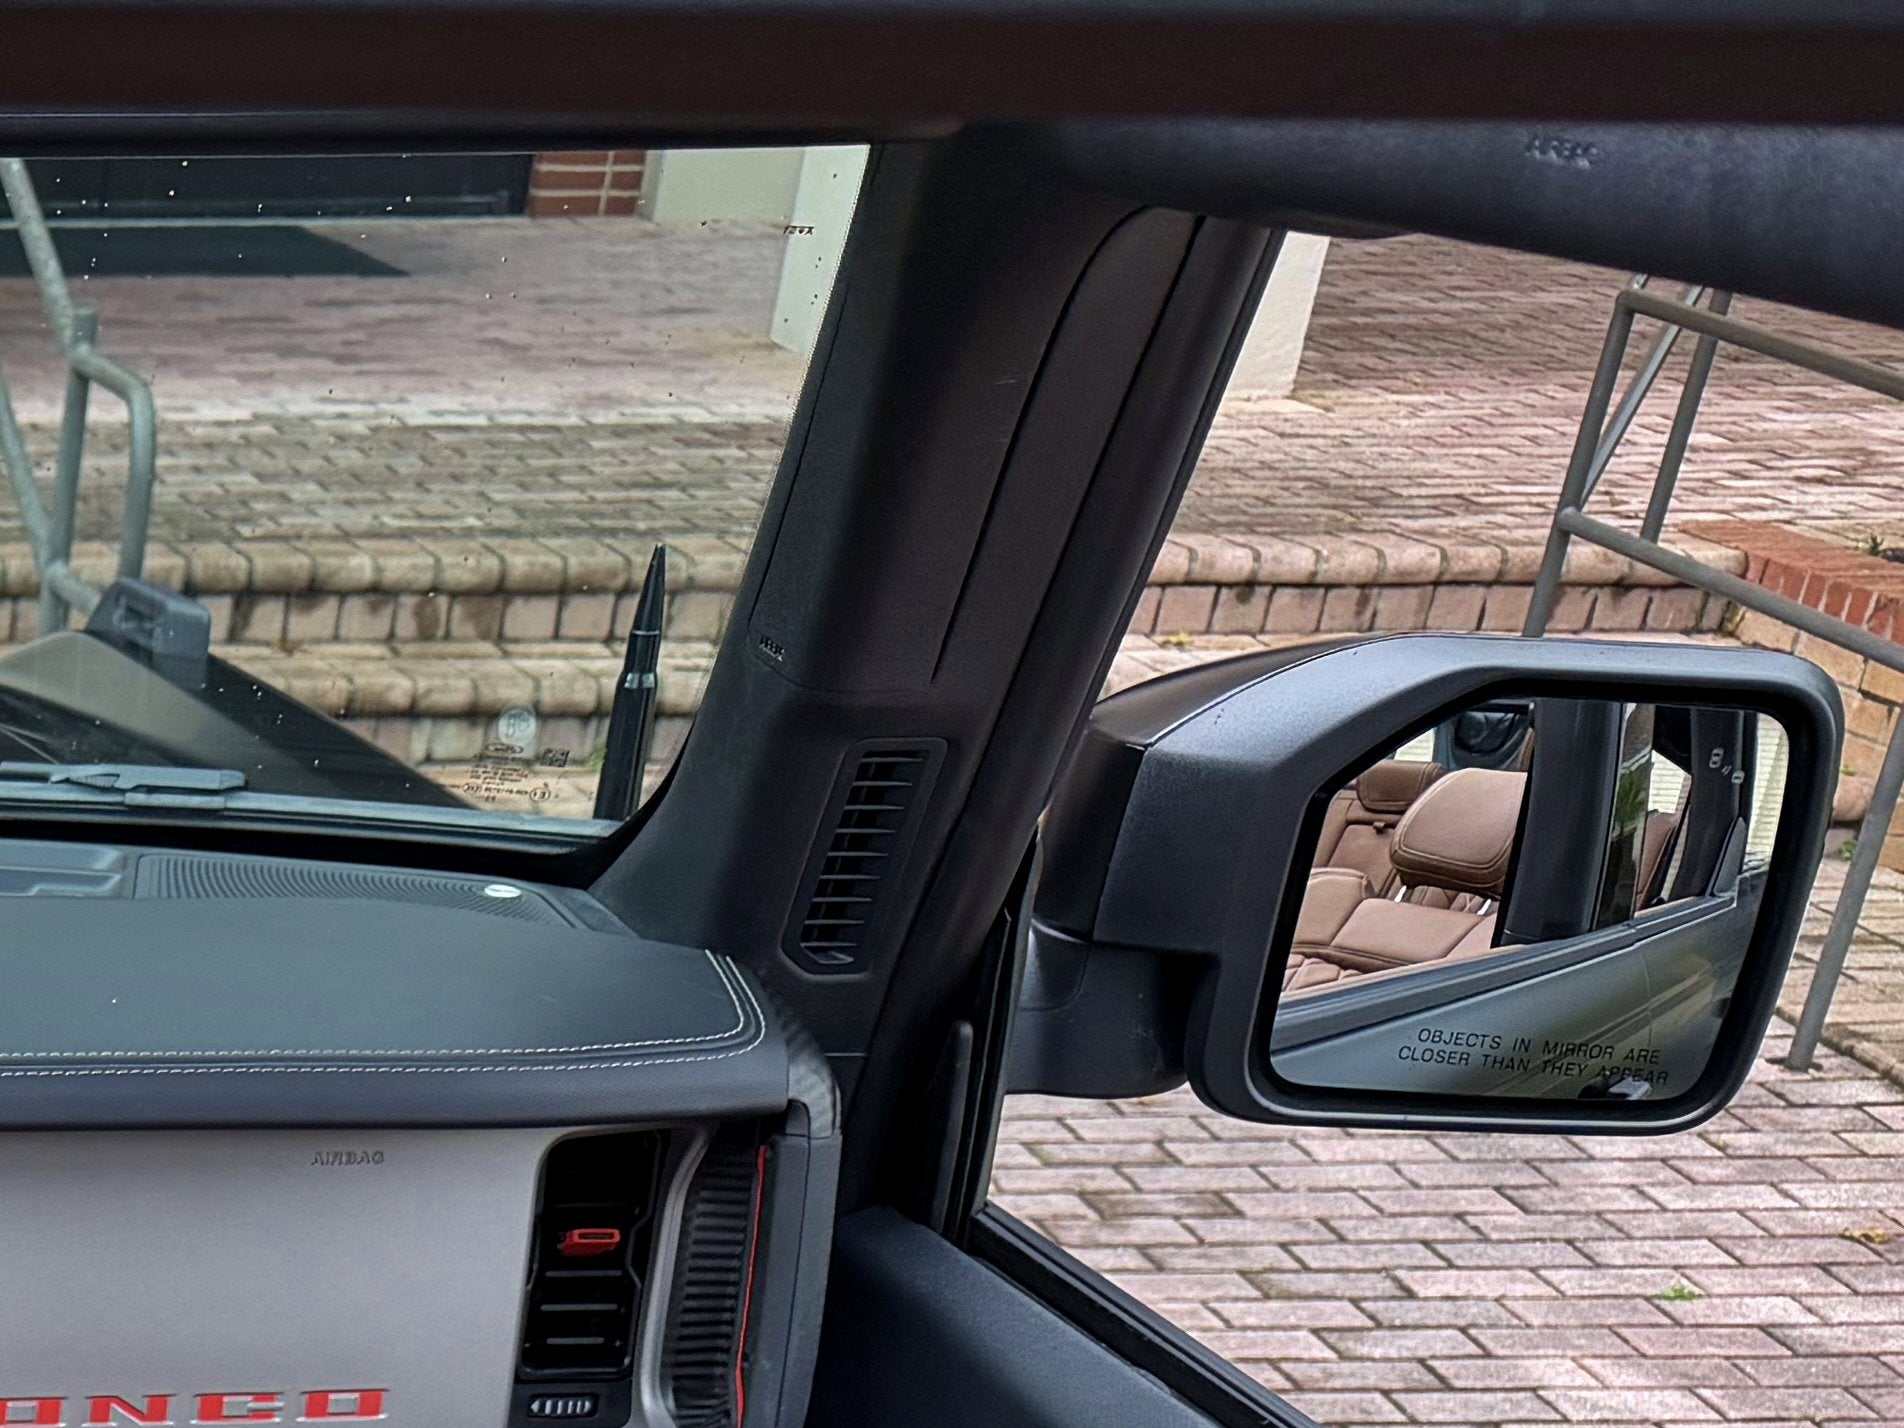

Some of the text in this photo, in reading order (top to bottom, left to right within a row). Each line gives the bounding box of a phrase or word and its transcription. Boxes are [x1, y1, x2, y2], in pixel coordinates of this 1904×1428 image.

[1398, 1046, 1669, 1086] CLOSER THAN THEY APPEAR
[1418, 1028, 1661, 1066] OBJECTS IN MIRROR ARE
[310, 1150, 384, 1166] AIRBAG
